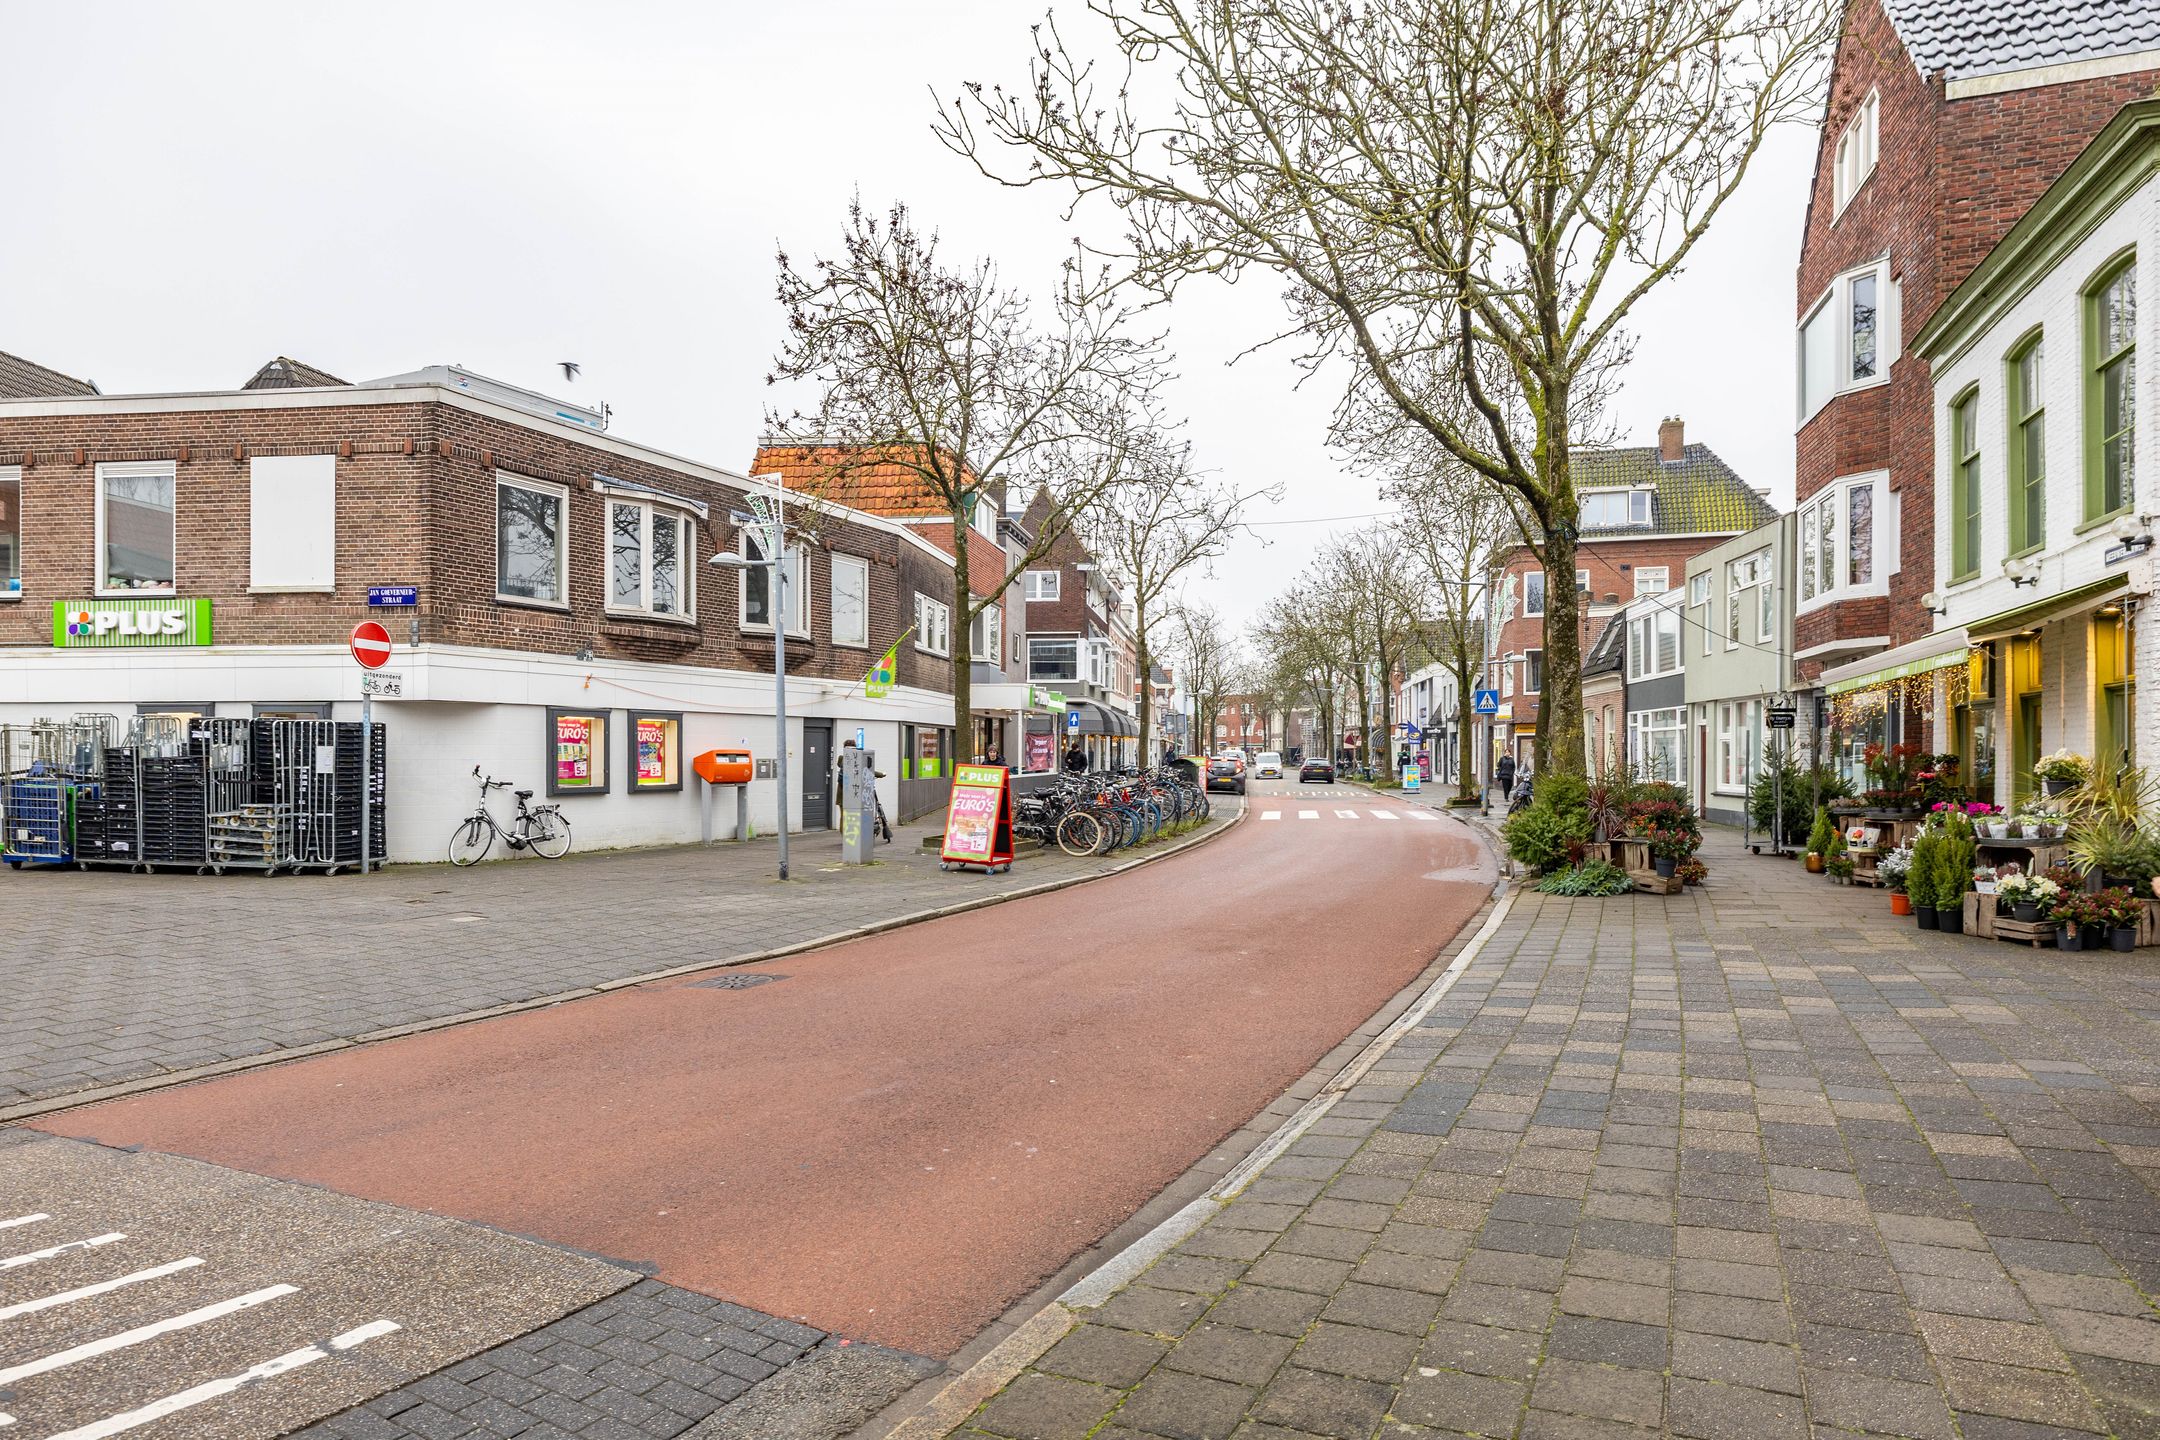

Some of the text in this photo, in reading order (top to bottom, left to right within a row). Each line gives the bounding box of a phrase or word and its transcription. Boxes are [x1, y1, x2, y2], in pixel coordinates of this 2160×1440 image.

[381, 588, 416, 596] GOEVERNEUR-
[95, 610, 188, 636] PLUS
[364, 671, 401, 680] uitgezonderd
[557, 727, 589, 740] URO'S
[638, 730, 663, 742] URO'S
[969, 772, 1000, 783] PLUS
[953, 798, 996, 812] EURO'S
